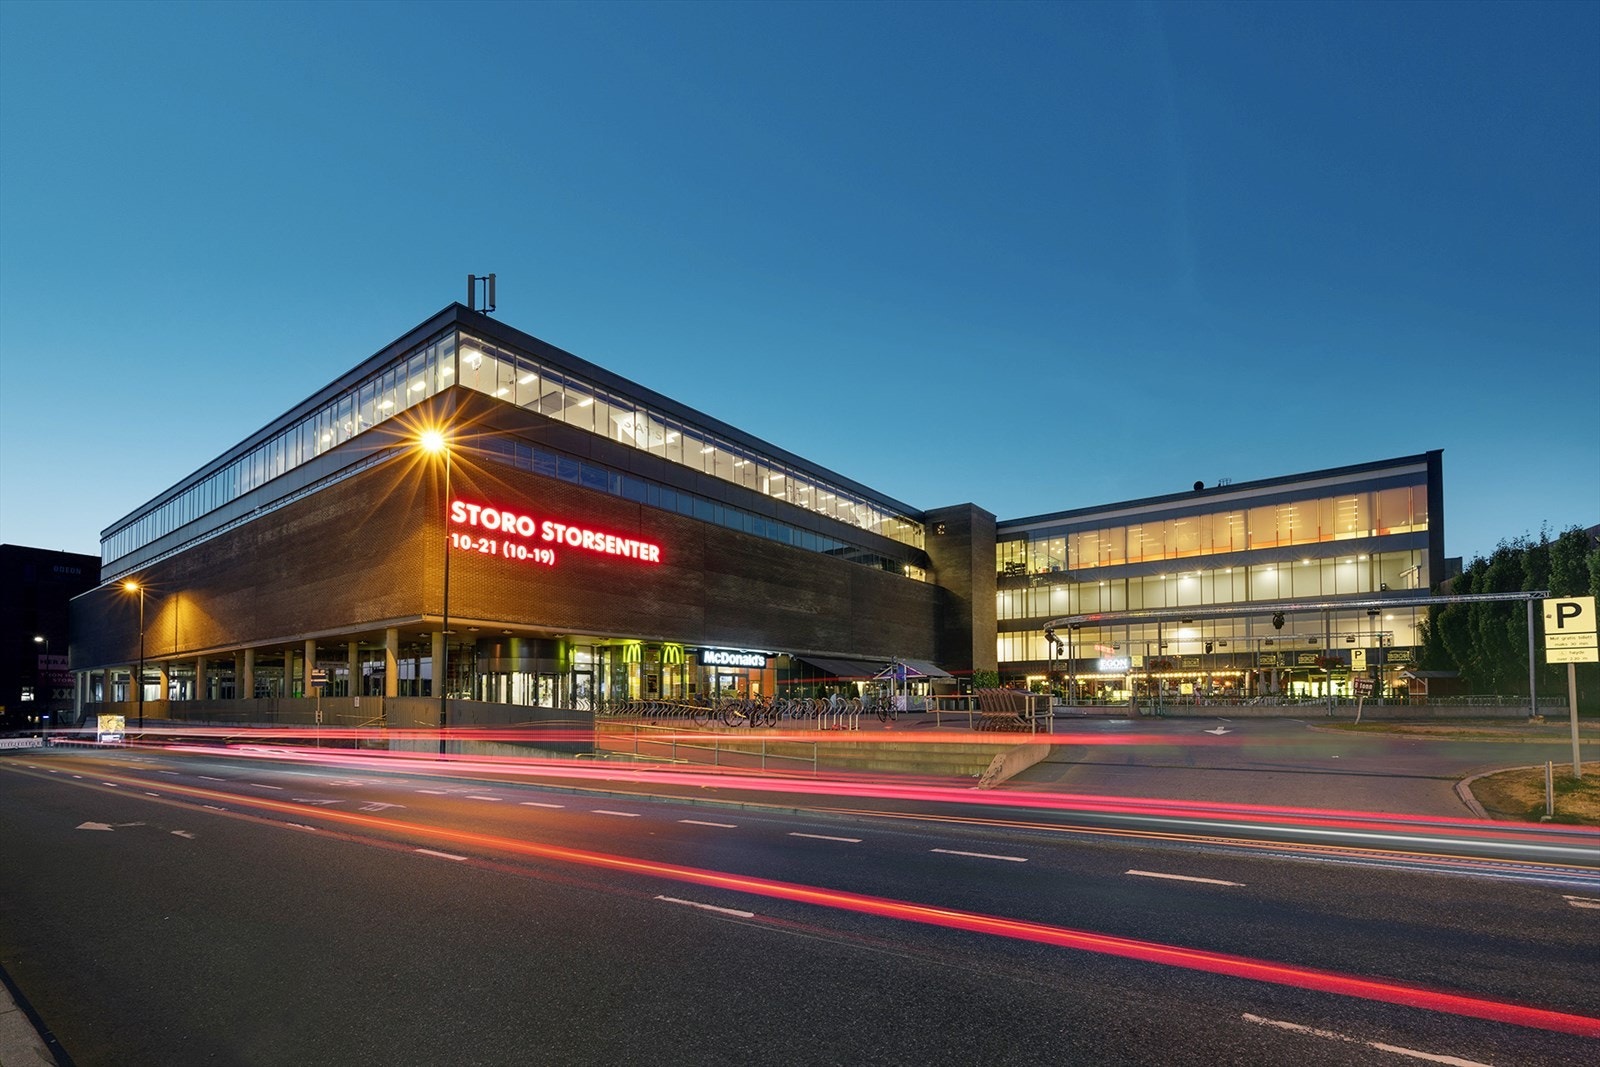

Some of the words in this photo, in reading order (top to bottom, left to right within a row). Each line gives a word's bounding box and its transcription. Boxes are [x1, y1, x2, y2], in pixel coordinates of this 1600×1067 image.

[451, 500, 536, 537] STORO
[541, 520, 661, 563] STORSENTER
[451, 533, 497, 555] 10-21
[503, 540, 555, 566] (10-19)
[1556, 602, 1582, 629] P
[703, 650, 766, 667] McDonald's
[1100, 658, 1128, 667] EGON
[1355, 650, 1362, 659] P
